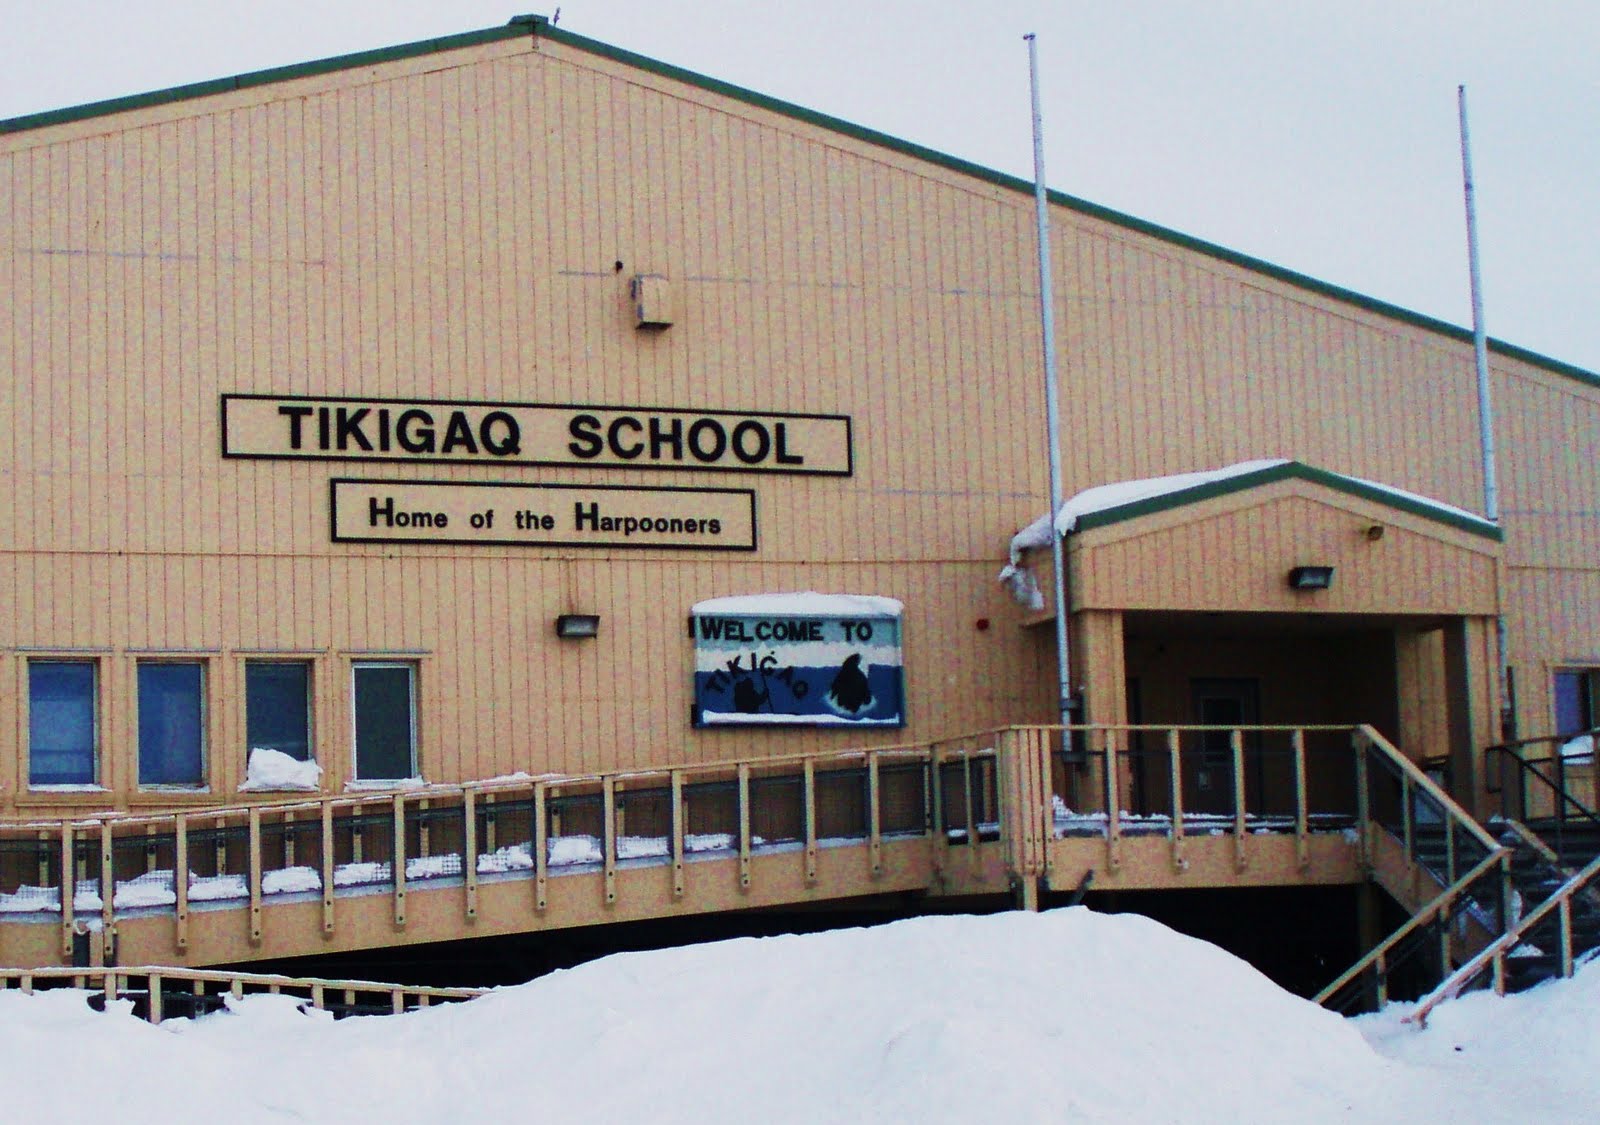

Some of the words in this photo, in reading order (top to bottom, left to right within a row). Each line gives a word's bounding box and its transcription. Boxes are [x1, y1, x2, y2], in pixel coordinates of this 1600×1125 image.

[278, 405, 521, 455] TIKIGAQ
[568, 414, 804, 464] SCHOOL
[369, 497, 448, 528] Home
[470, 510, 494, 529] of
[515, 510, 555, 530] the
[575, 502, 722, 535] Harpooners
[701, 615, 824, 642] WELCOME
[841, 620, 873, 641] TO
